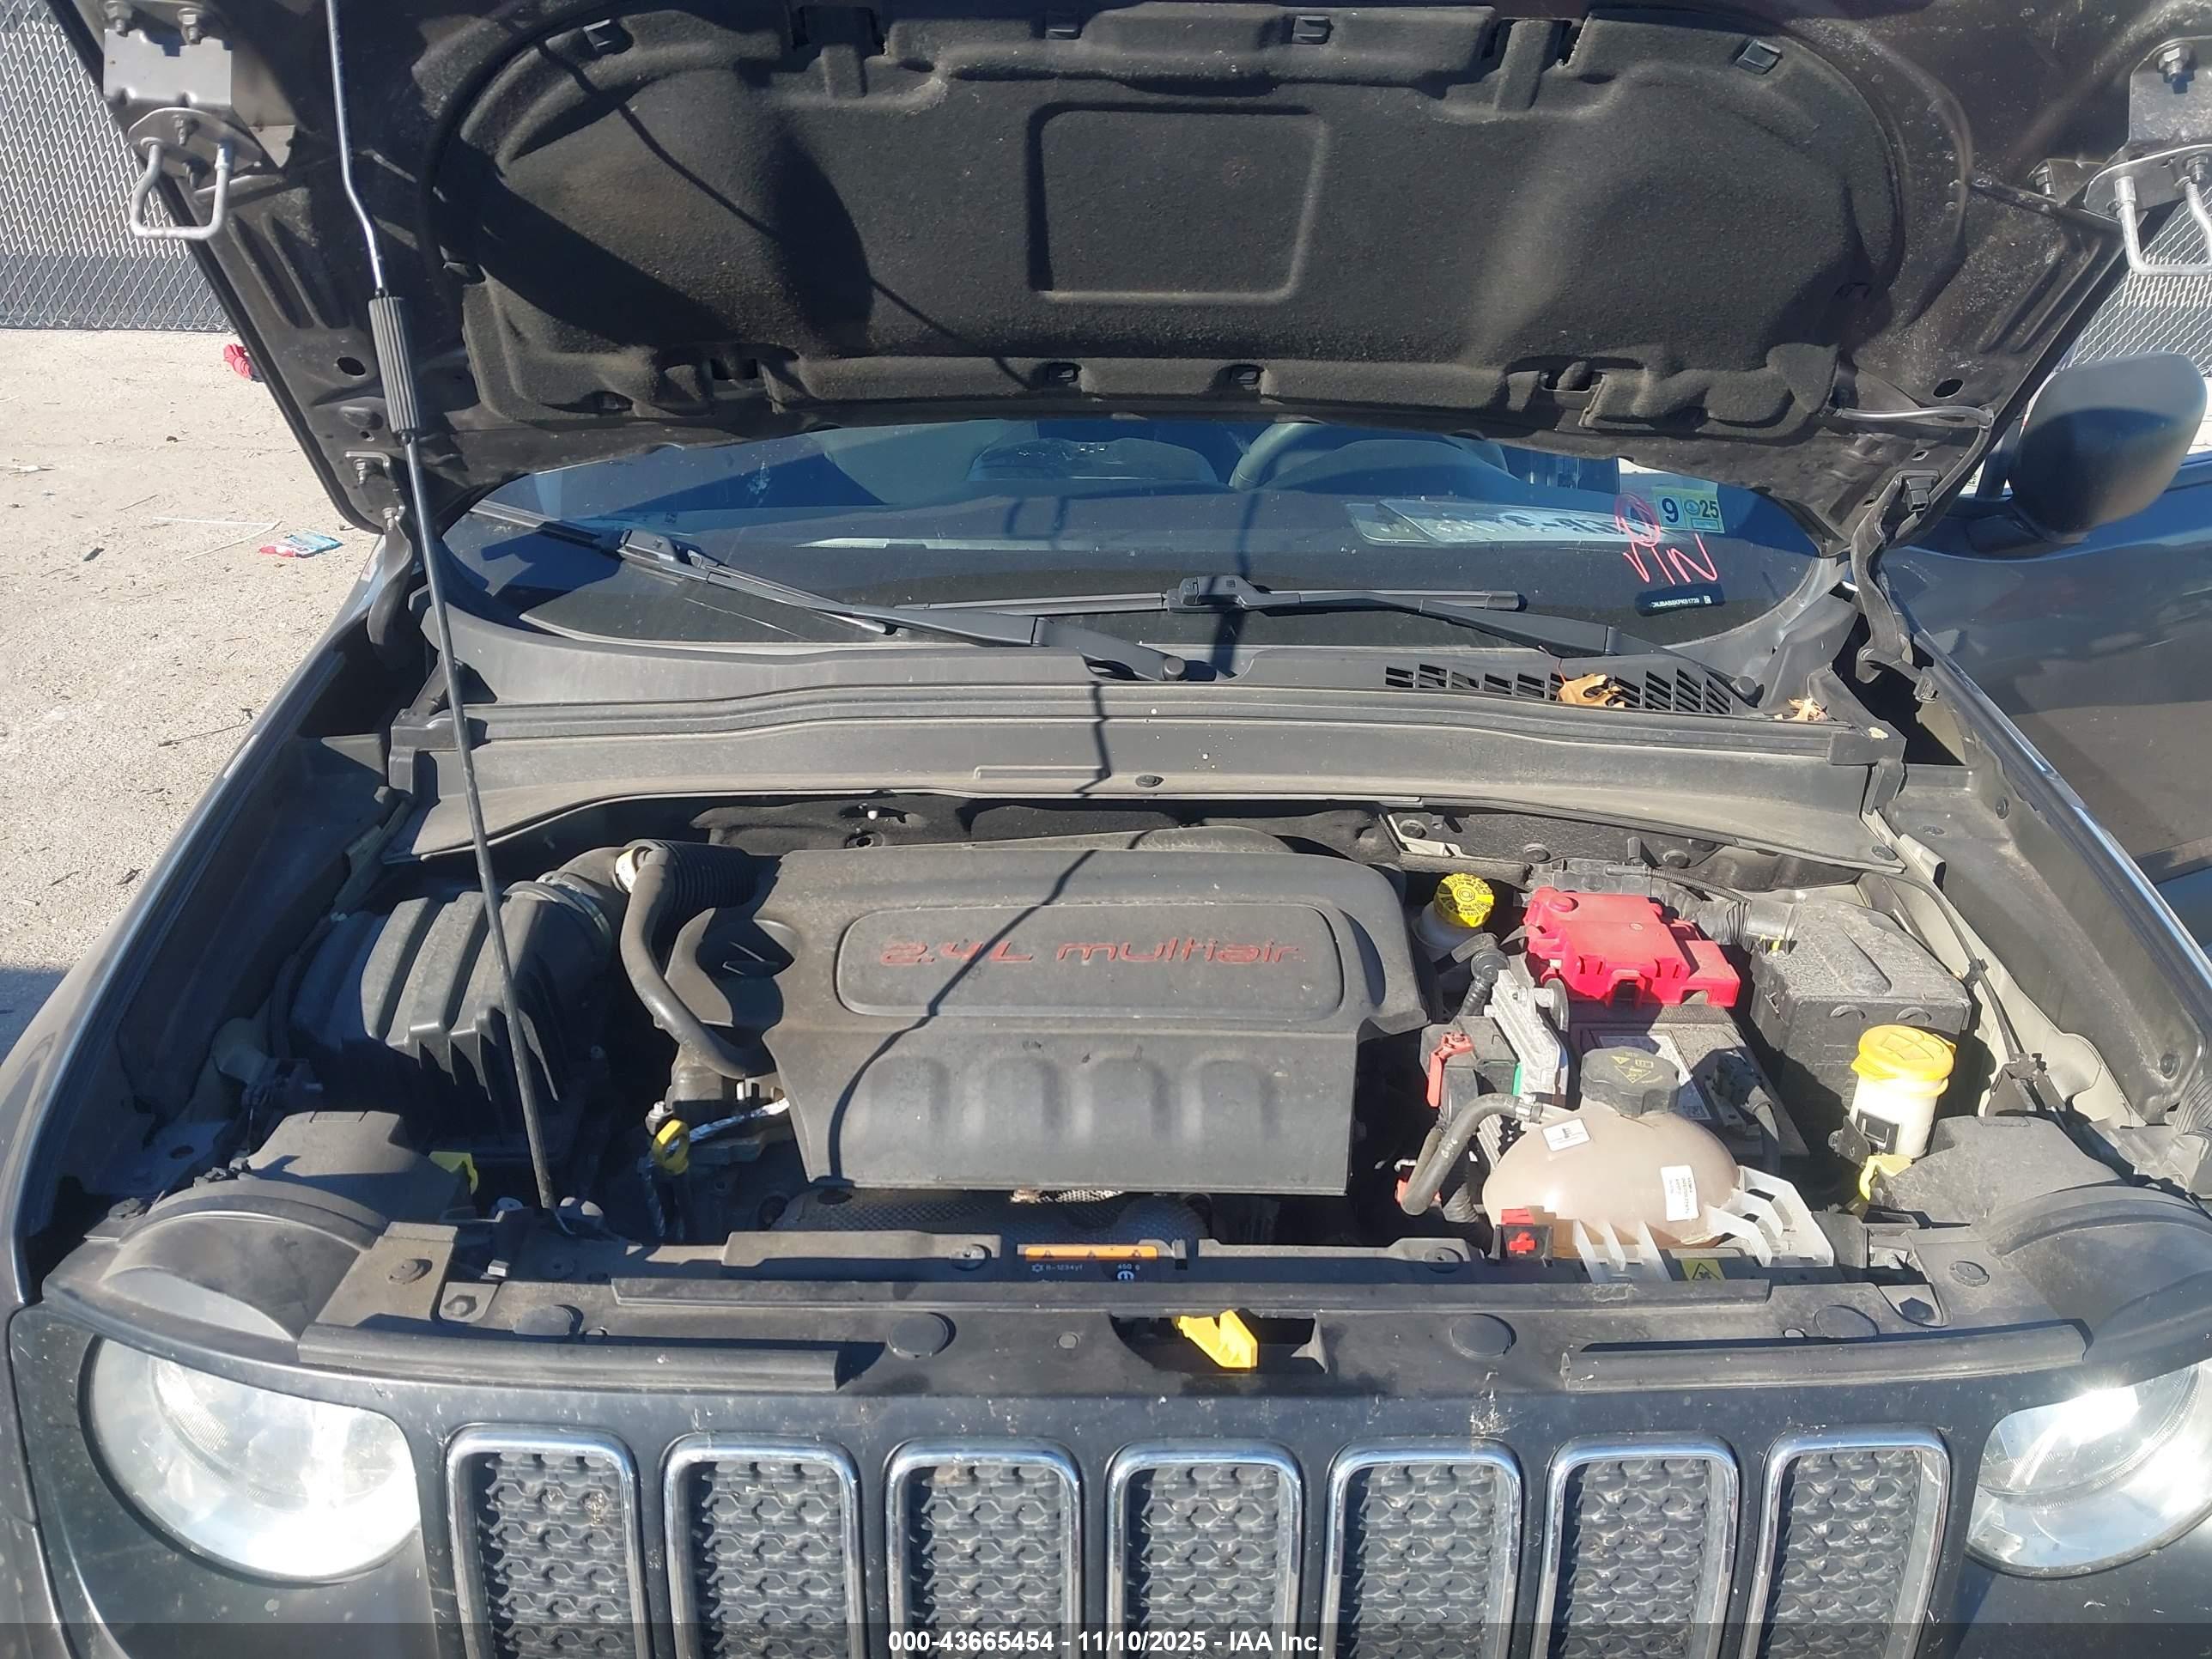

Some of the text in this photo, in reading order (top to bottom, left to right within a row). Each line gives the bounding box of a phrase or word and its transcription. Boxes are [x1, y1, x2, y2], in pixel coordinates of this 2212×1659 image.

[1662, 497, 1718, 523] 9 25
[881, 937, 1299, 965] 2.4L multiair
